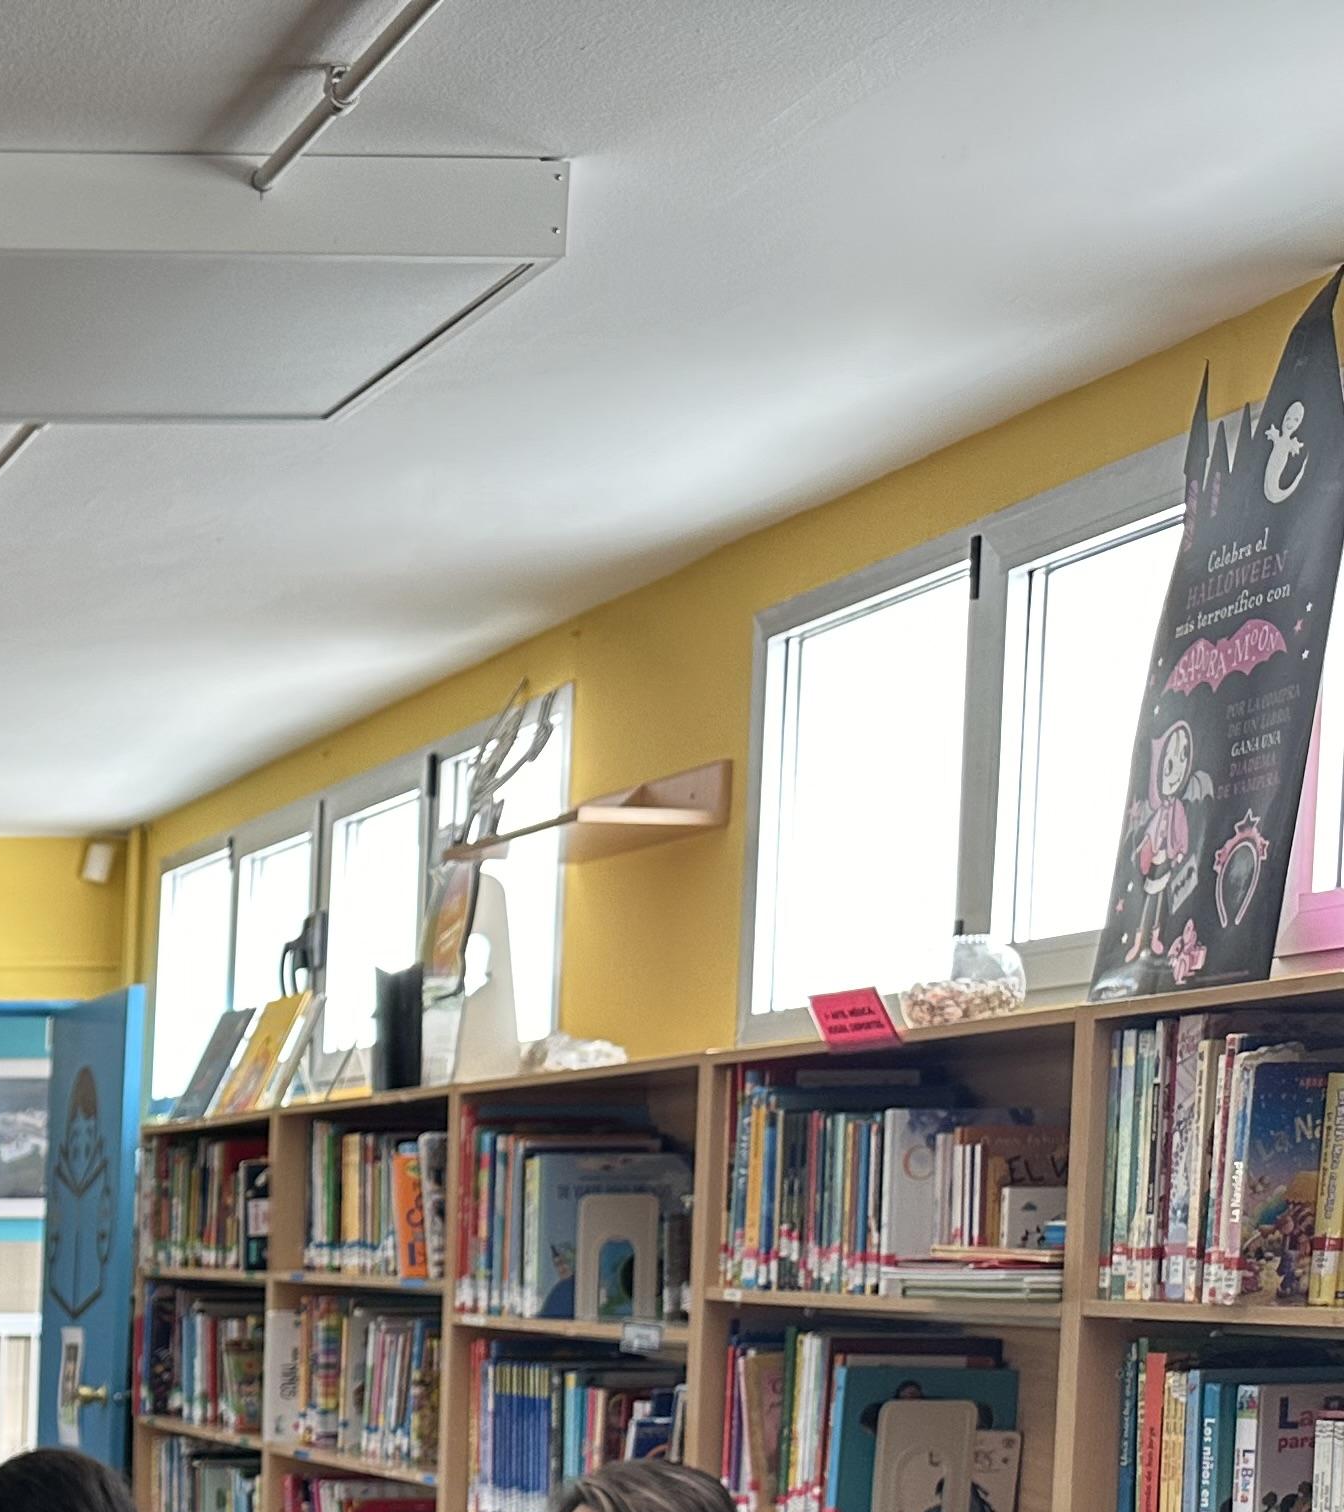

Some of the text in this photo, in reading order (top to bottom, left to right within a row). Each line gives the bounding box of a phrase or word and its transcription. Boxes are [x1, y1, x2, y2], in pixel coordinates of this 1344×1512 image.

[1207, 527, 1269, 572] Celebra el
[1186, 550, 1288, 610] HALLOWEEN
[1197, 589, 1263, 630] terrorífico
[1266, 583, 1291, 603] con
[1230, 1161, 1243, 1223] La Navidad
[1201, 1418, 1216, 1443] Los
[1200, 1449, 1214, 1486] niños
[1200, 1490, 1210, 1508] en
